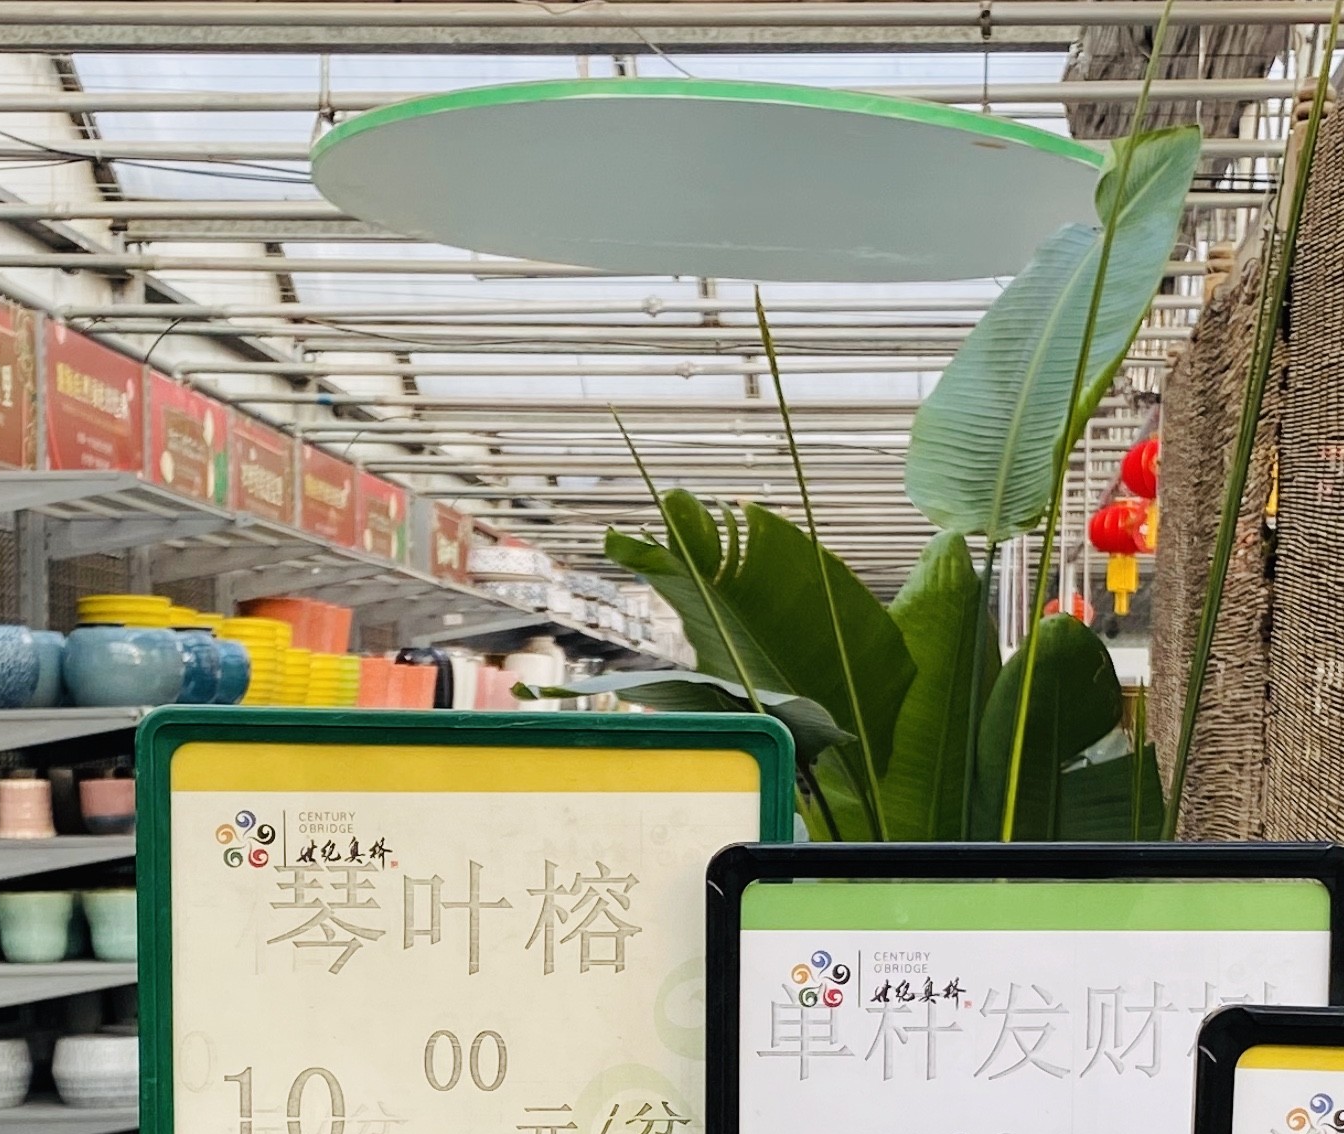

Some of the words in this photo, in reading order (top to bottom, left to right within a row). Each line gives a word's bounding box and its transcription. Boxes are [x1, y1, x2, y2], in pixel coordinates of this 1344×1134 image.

[298, 811, 356, 822] CENTURY
[266, 860, 643, 976] 琴叶榕
[873, 951, 931, 962] CENTURY
[424, 1029, 508, 1093] 00
